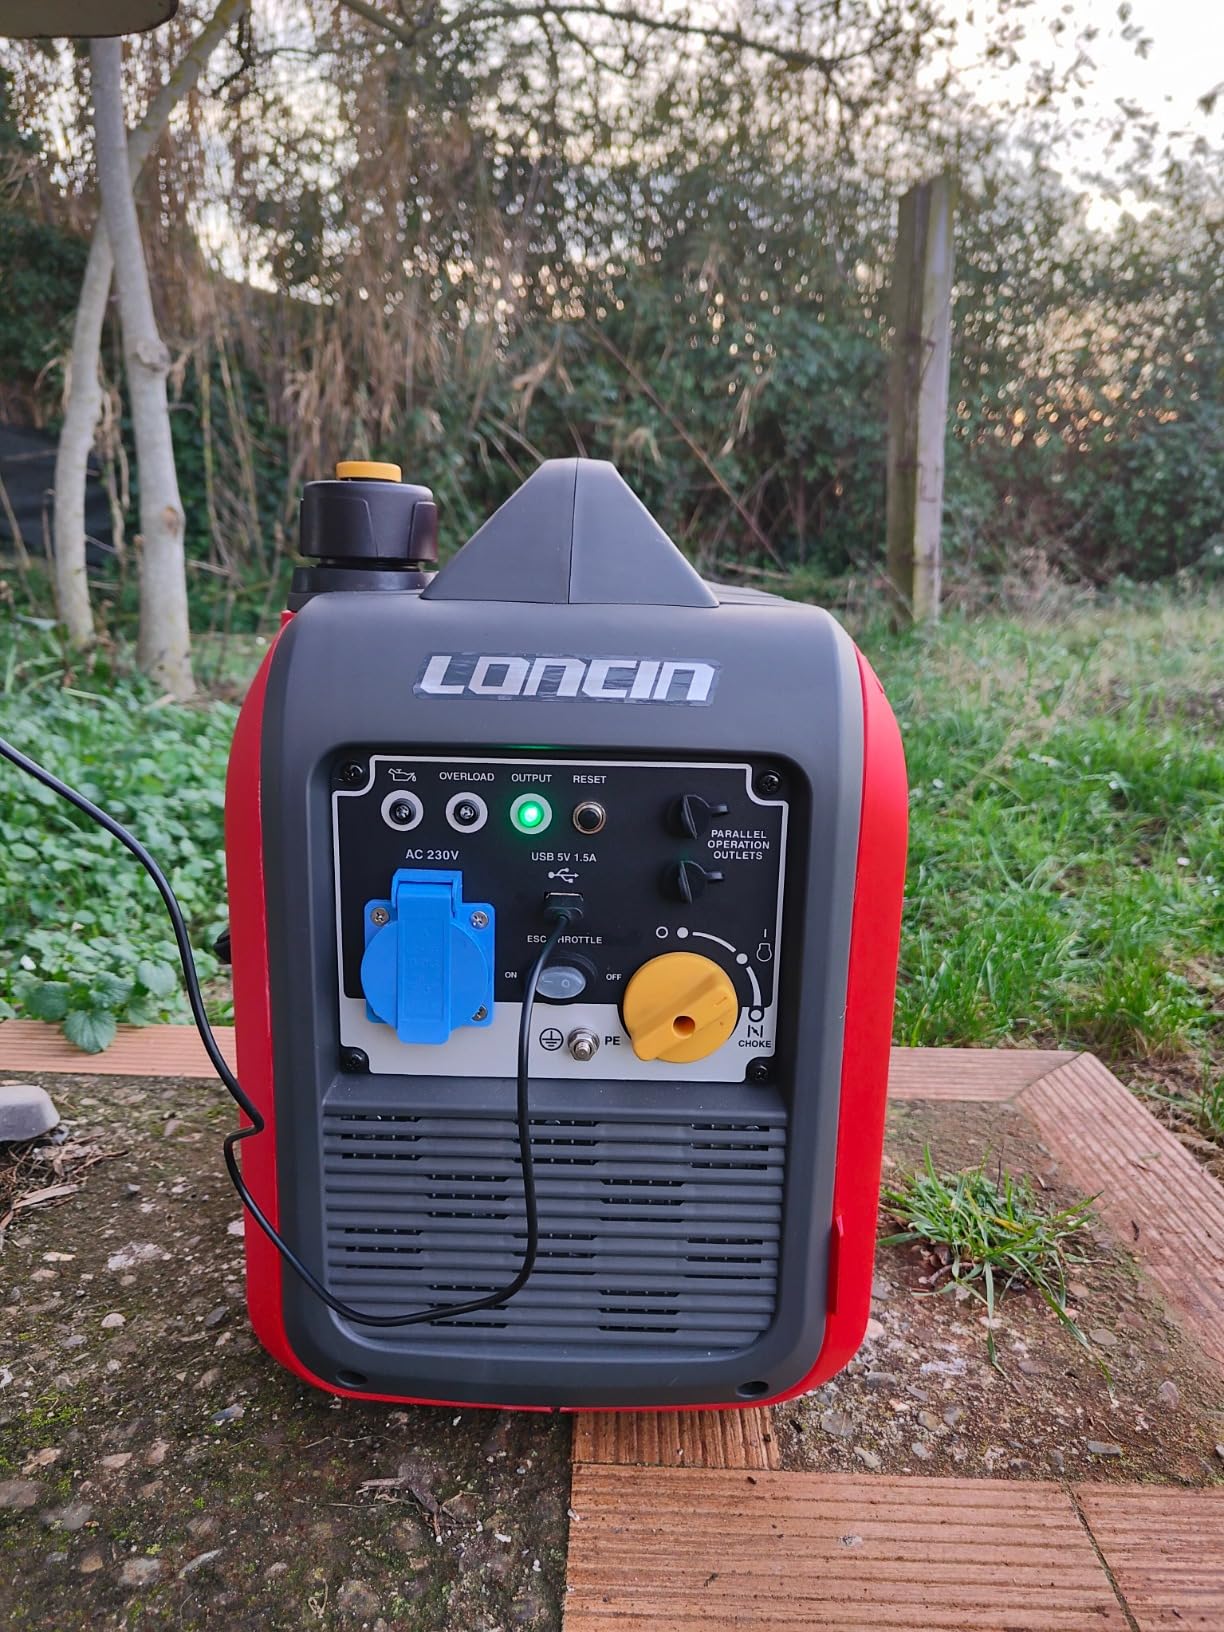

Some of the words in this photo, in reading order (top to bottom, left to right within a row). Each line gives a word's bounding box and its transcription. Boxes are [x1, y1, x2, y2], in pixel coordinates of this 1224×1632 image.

[420, 655, 715, 700] LONCIN
[439, 771, 495, 782] OVERLOAD
[511, 773, 553, 783] OUTPUT
[573, 775, 607, 784] RESET
[711, 829, 767, 839] PARALLEL
[707, 840, 770, 849] OPERATION
[405, 849, 423, 860] AC
[426, 850, 459, 860] 230V
[531, 852, 554, 862] USB
[557, 853, 571, 862] 5V
[574, 853, 597, 862] 1.5A
[713, 851, 763, 860] OUTLETS
[527, 935, 547, 943] ESC
[553, 936, 603, 945] HROTTLE
[504, 971, 518, 979] ON
[605, 973, 622, 981] OFF
[604, 1036, 621, 1046] PE
[738, 1040, 772, 1048] CHOKE
